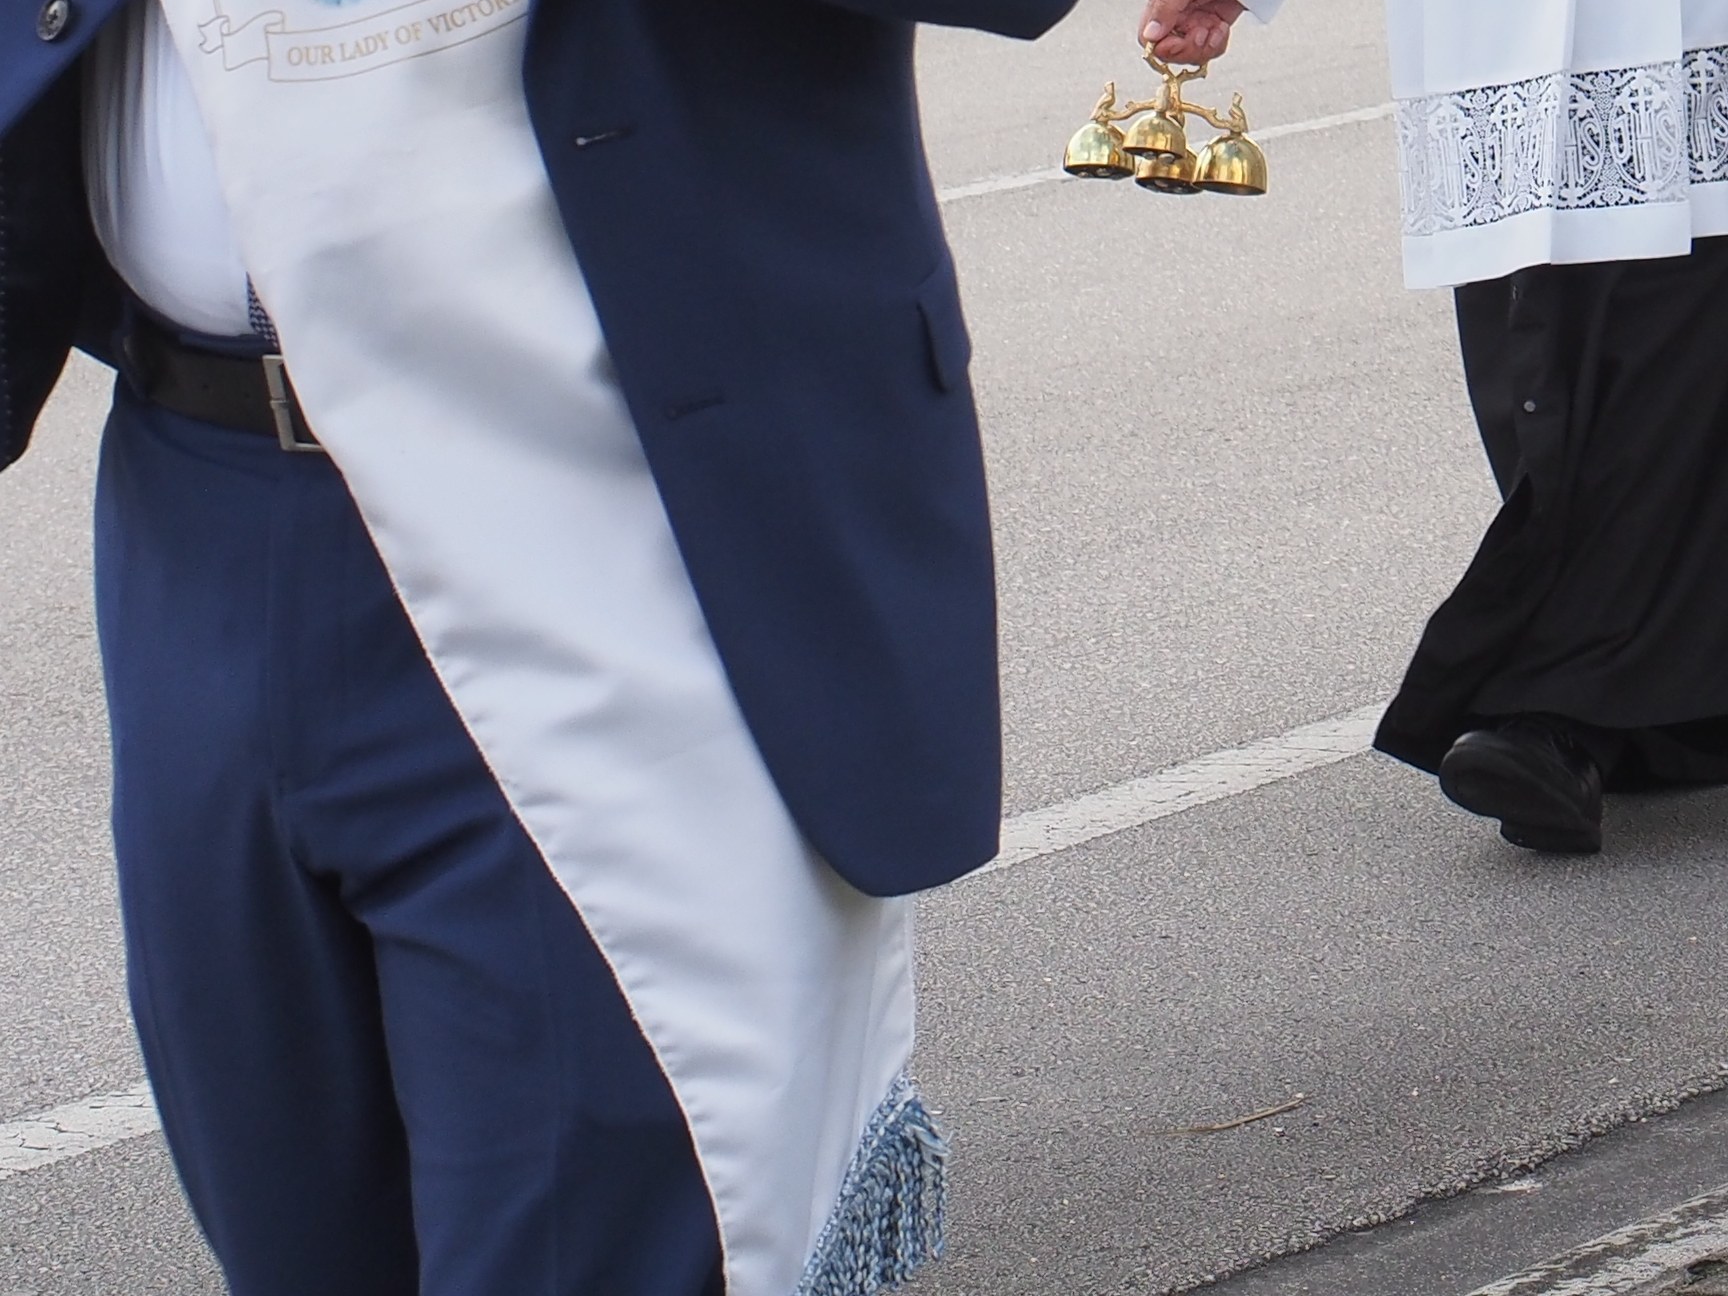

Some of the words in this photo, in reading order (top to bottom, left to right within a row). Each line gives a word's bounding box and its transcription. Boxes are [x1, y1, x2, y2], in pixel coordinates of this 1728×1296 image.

[287, 45, 334, 66] OUR
[340, 31, 391, 61] LADY
[394, 21, 424, 45] OF
